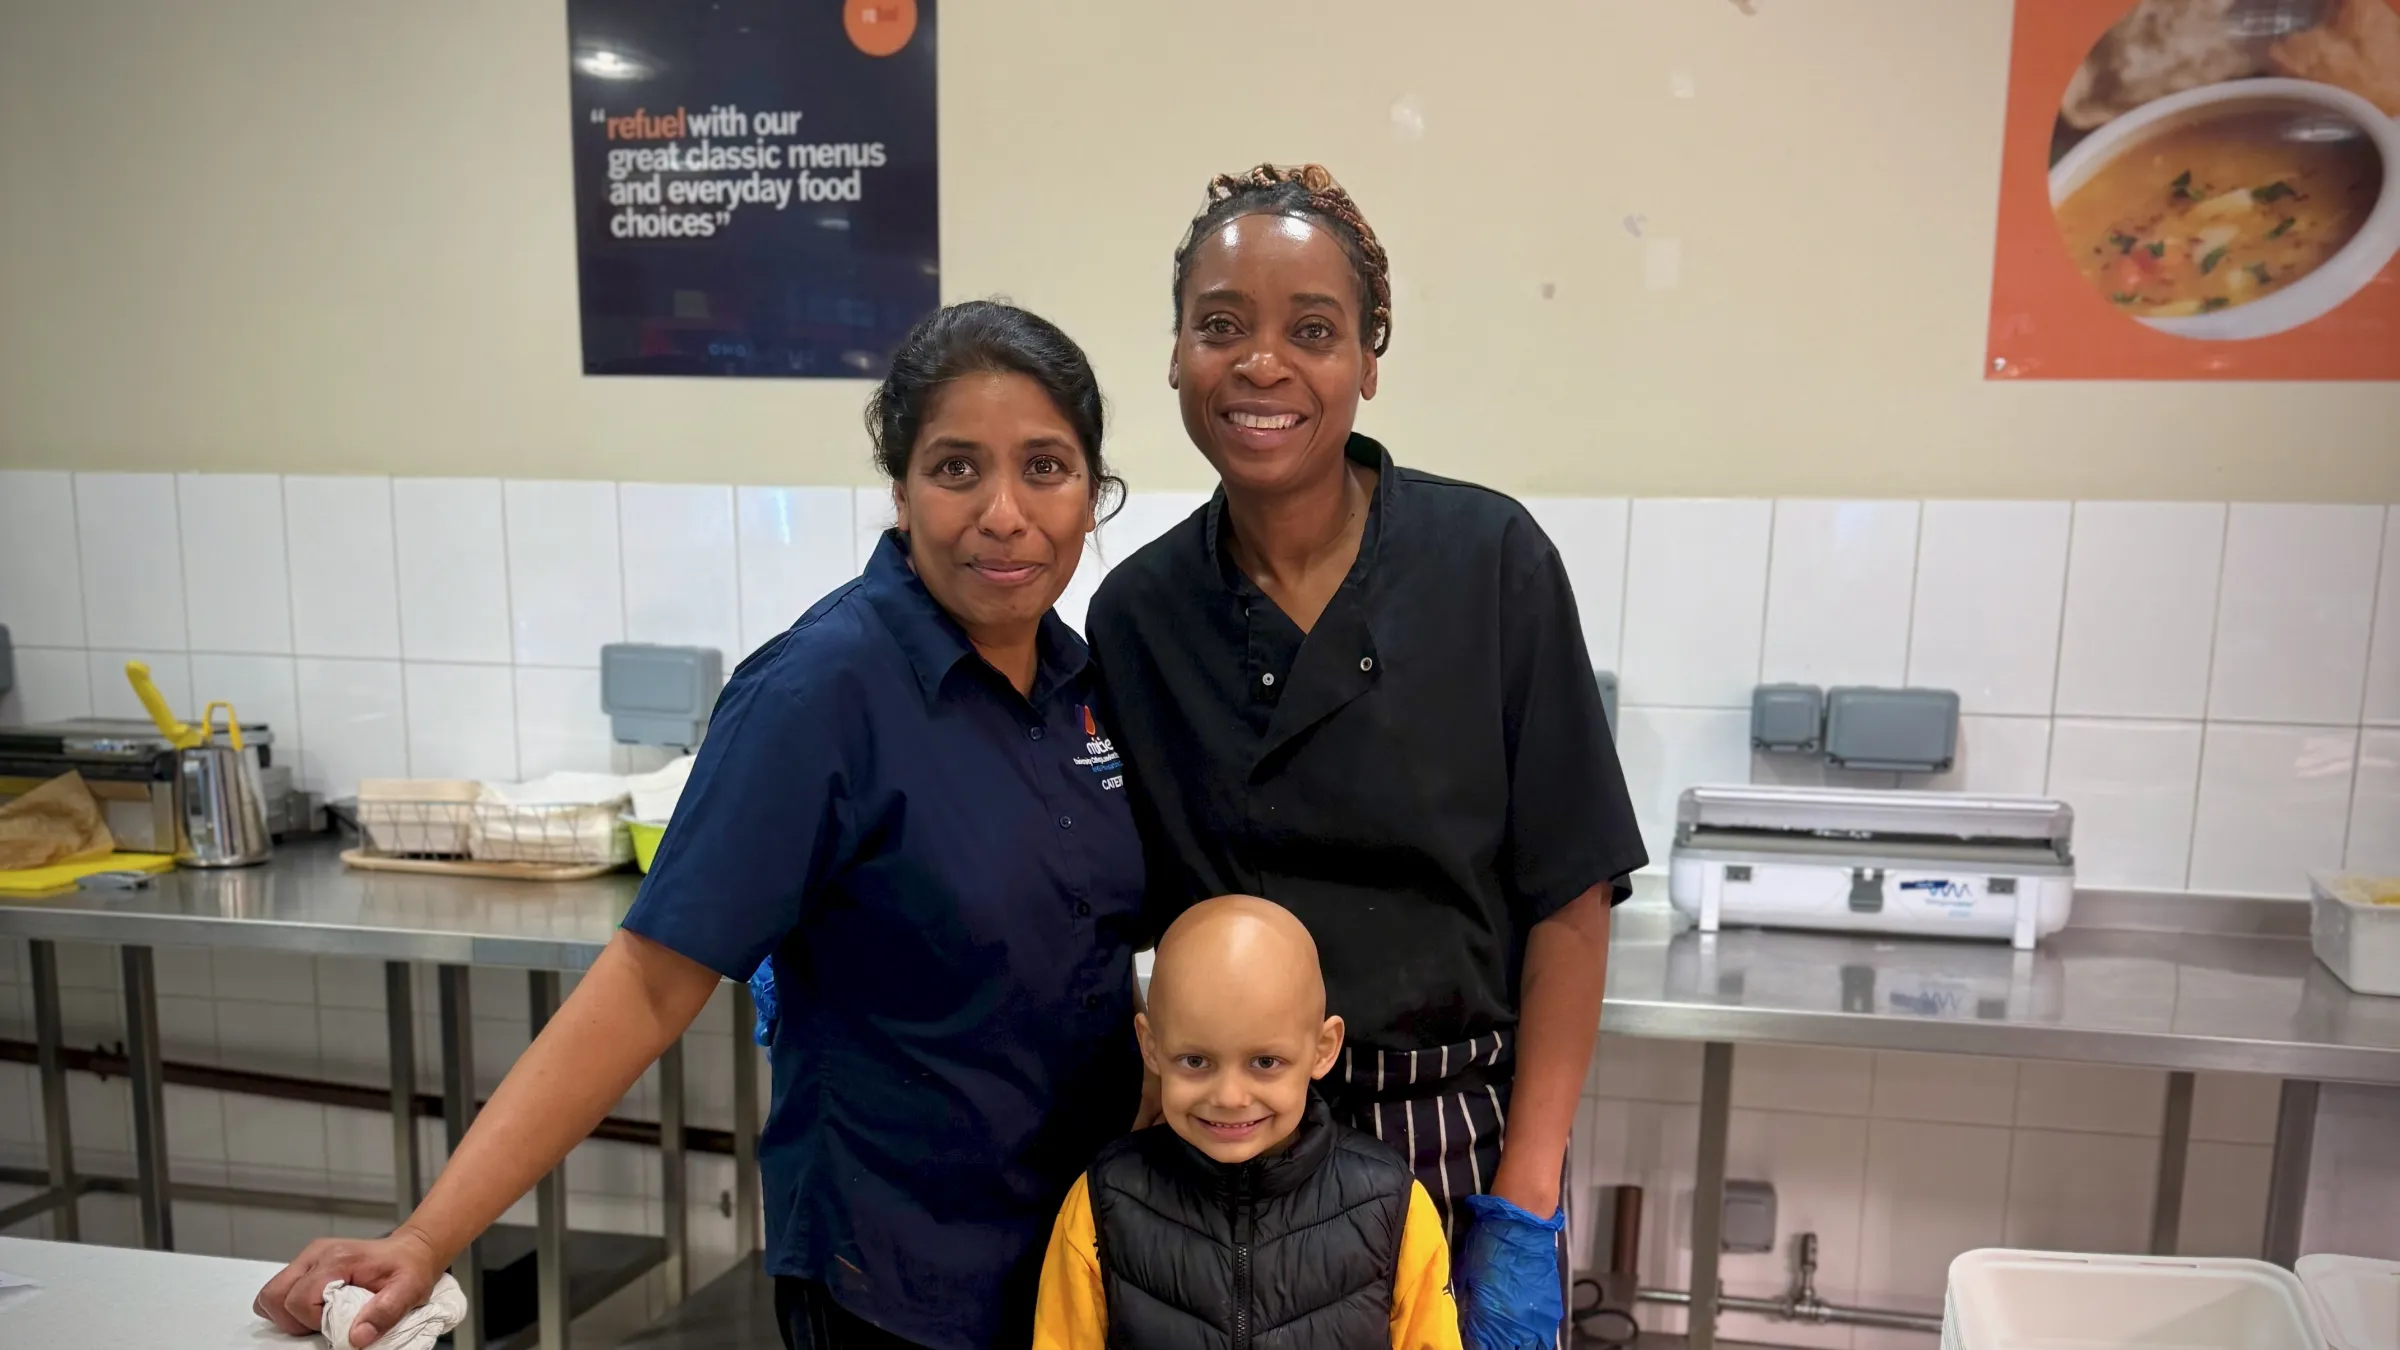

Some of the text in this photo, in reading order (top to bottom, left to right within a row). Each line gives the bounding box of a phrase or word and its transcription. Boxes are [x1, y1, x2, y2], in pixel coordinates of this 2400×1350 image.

[590, 104, 802, 140] “refuel with our
[607, 137, 887, 180] great classic menus
[609, 169, 861, 211] and everyday food
[610, 205, 731, 238] choices”
